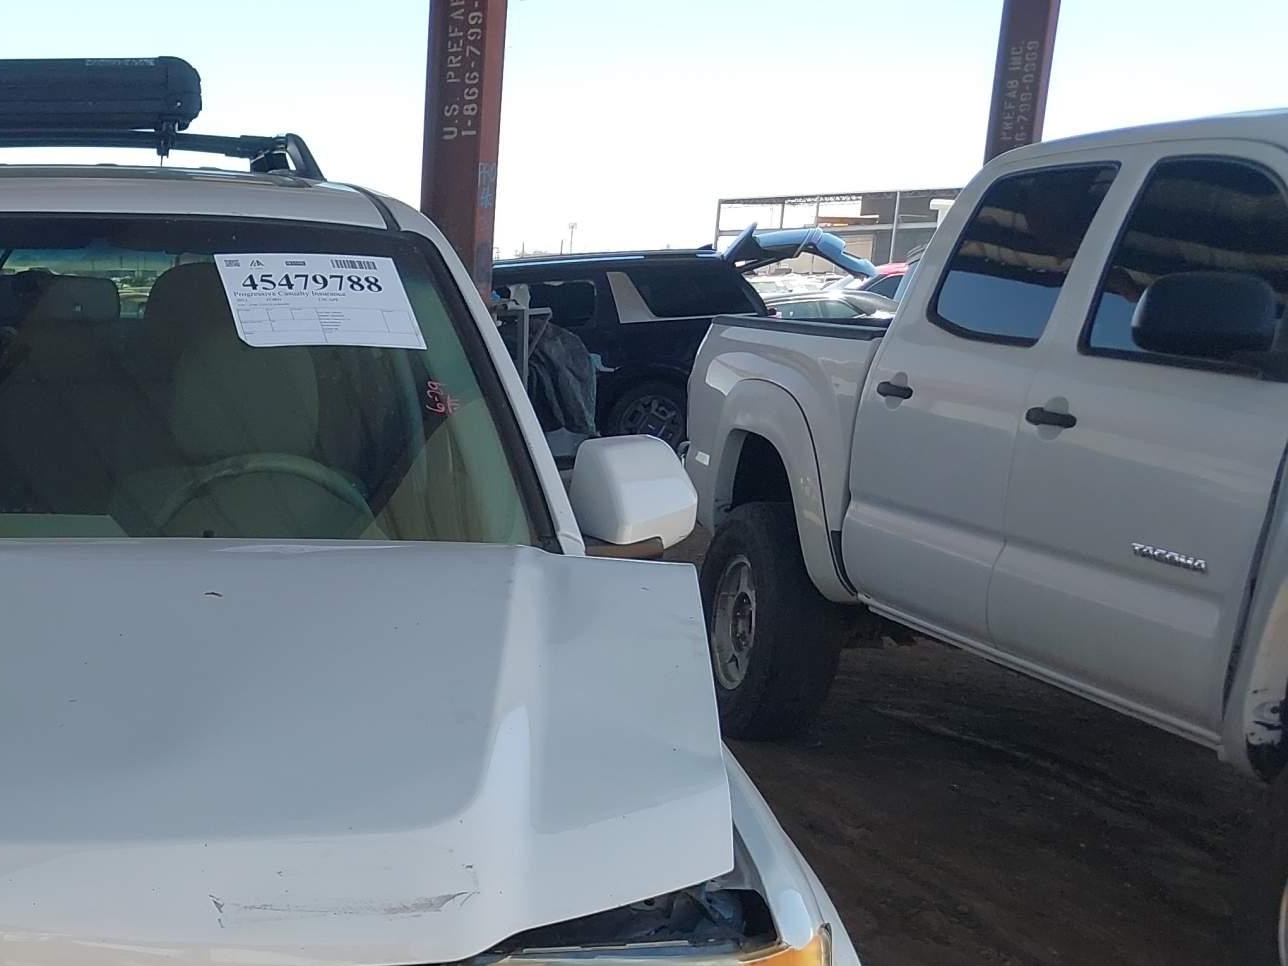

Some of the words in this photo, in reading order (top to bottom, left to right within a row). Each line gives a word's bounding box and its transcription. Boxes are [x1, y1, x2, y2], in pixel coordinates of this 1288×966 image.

[442, 97, 460, 140] U.S.
[1000, 79, 1019, 141] PREFAB
[242, 273, 383, 292] 45479788
[1131, 542, 1207, 571] TACOMA
